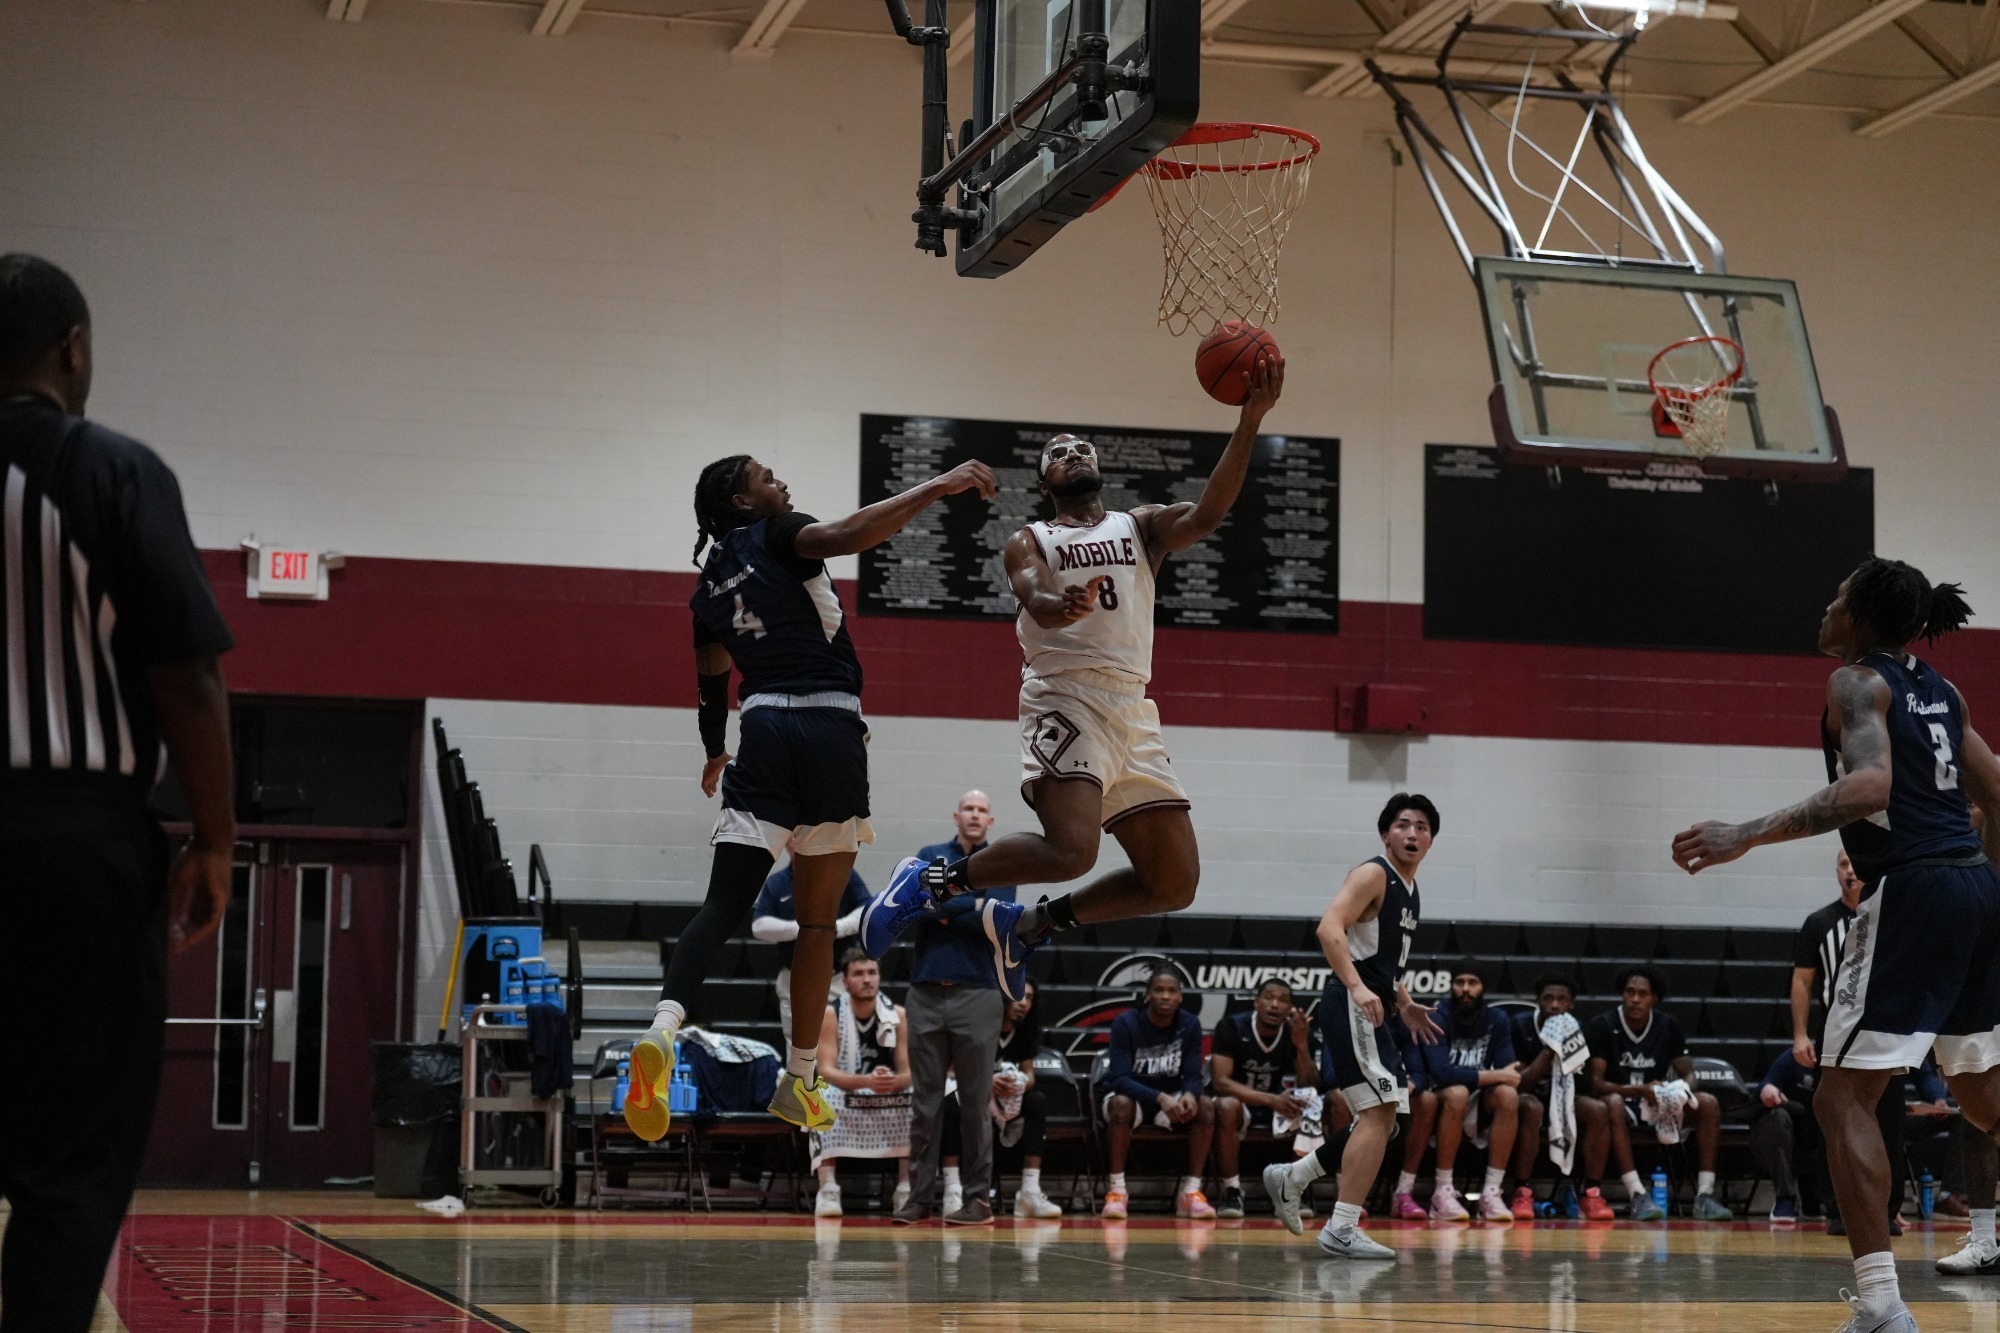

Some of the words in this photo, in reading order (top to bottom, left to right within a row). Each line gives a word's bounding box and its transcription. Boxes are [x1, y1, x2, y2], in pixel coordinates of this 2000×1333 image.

[271, 551, 309, 580] EXIT
[1054, 537, 1137, 571] MOBILE
[1098, 574, 1119, 611] 8
[732, 592, 768, 640] 4
[1927, 722, 1958, 791] 2
[1196, 965, 1333, 990] UNIVERSIT
[1400, 970, 1452, 994] MOB
